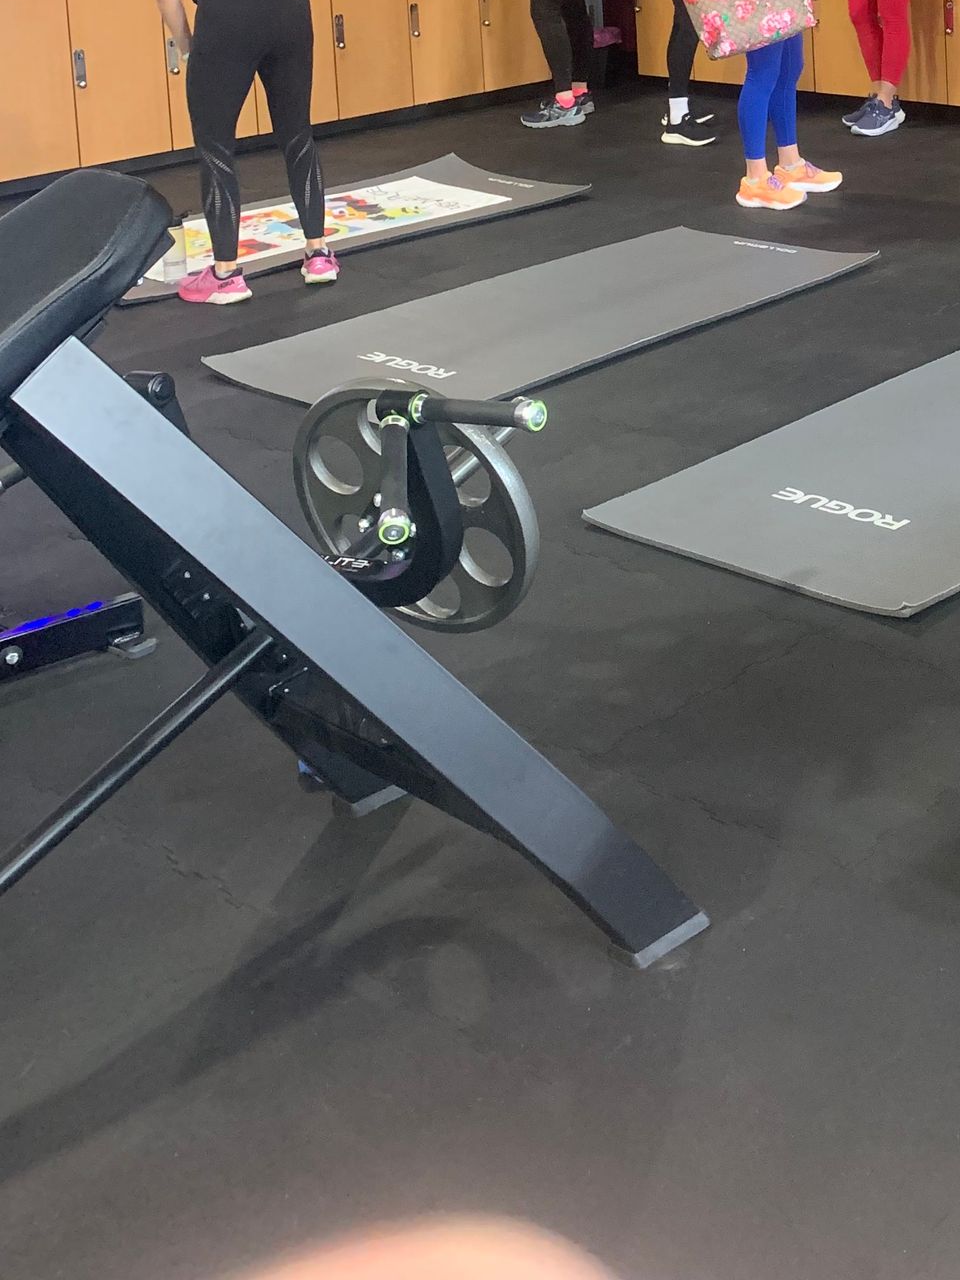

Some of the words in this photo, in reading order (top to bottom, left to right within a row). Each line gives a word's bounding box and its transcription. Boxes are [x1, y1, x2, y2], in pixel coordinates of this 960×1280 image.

[356, 351, 458, 379] ROGUE
[770, 486, 911, 531] ROGUE
[321, 555, 370, 569] LITE
